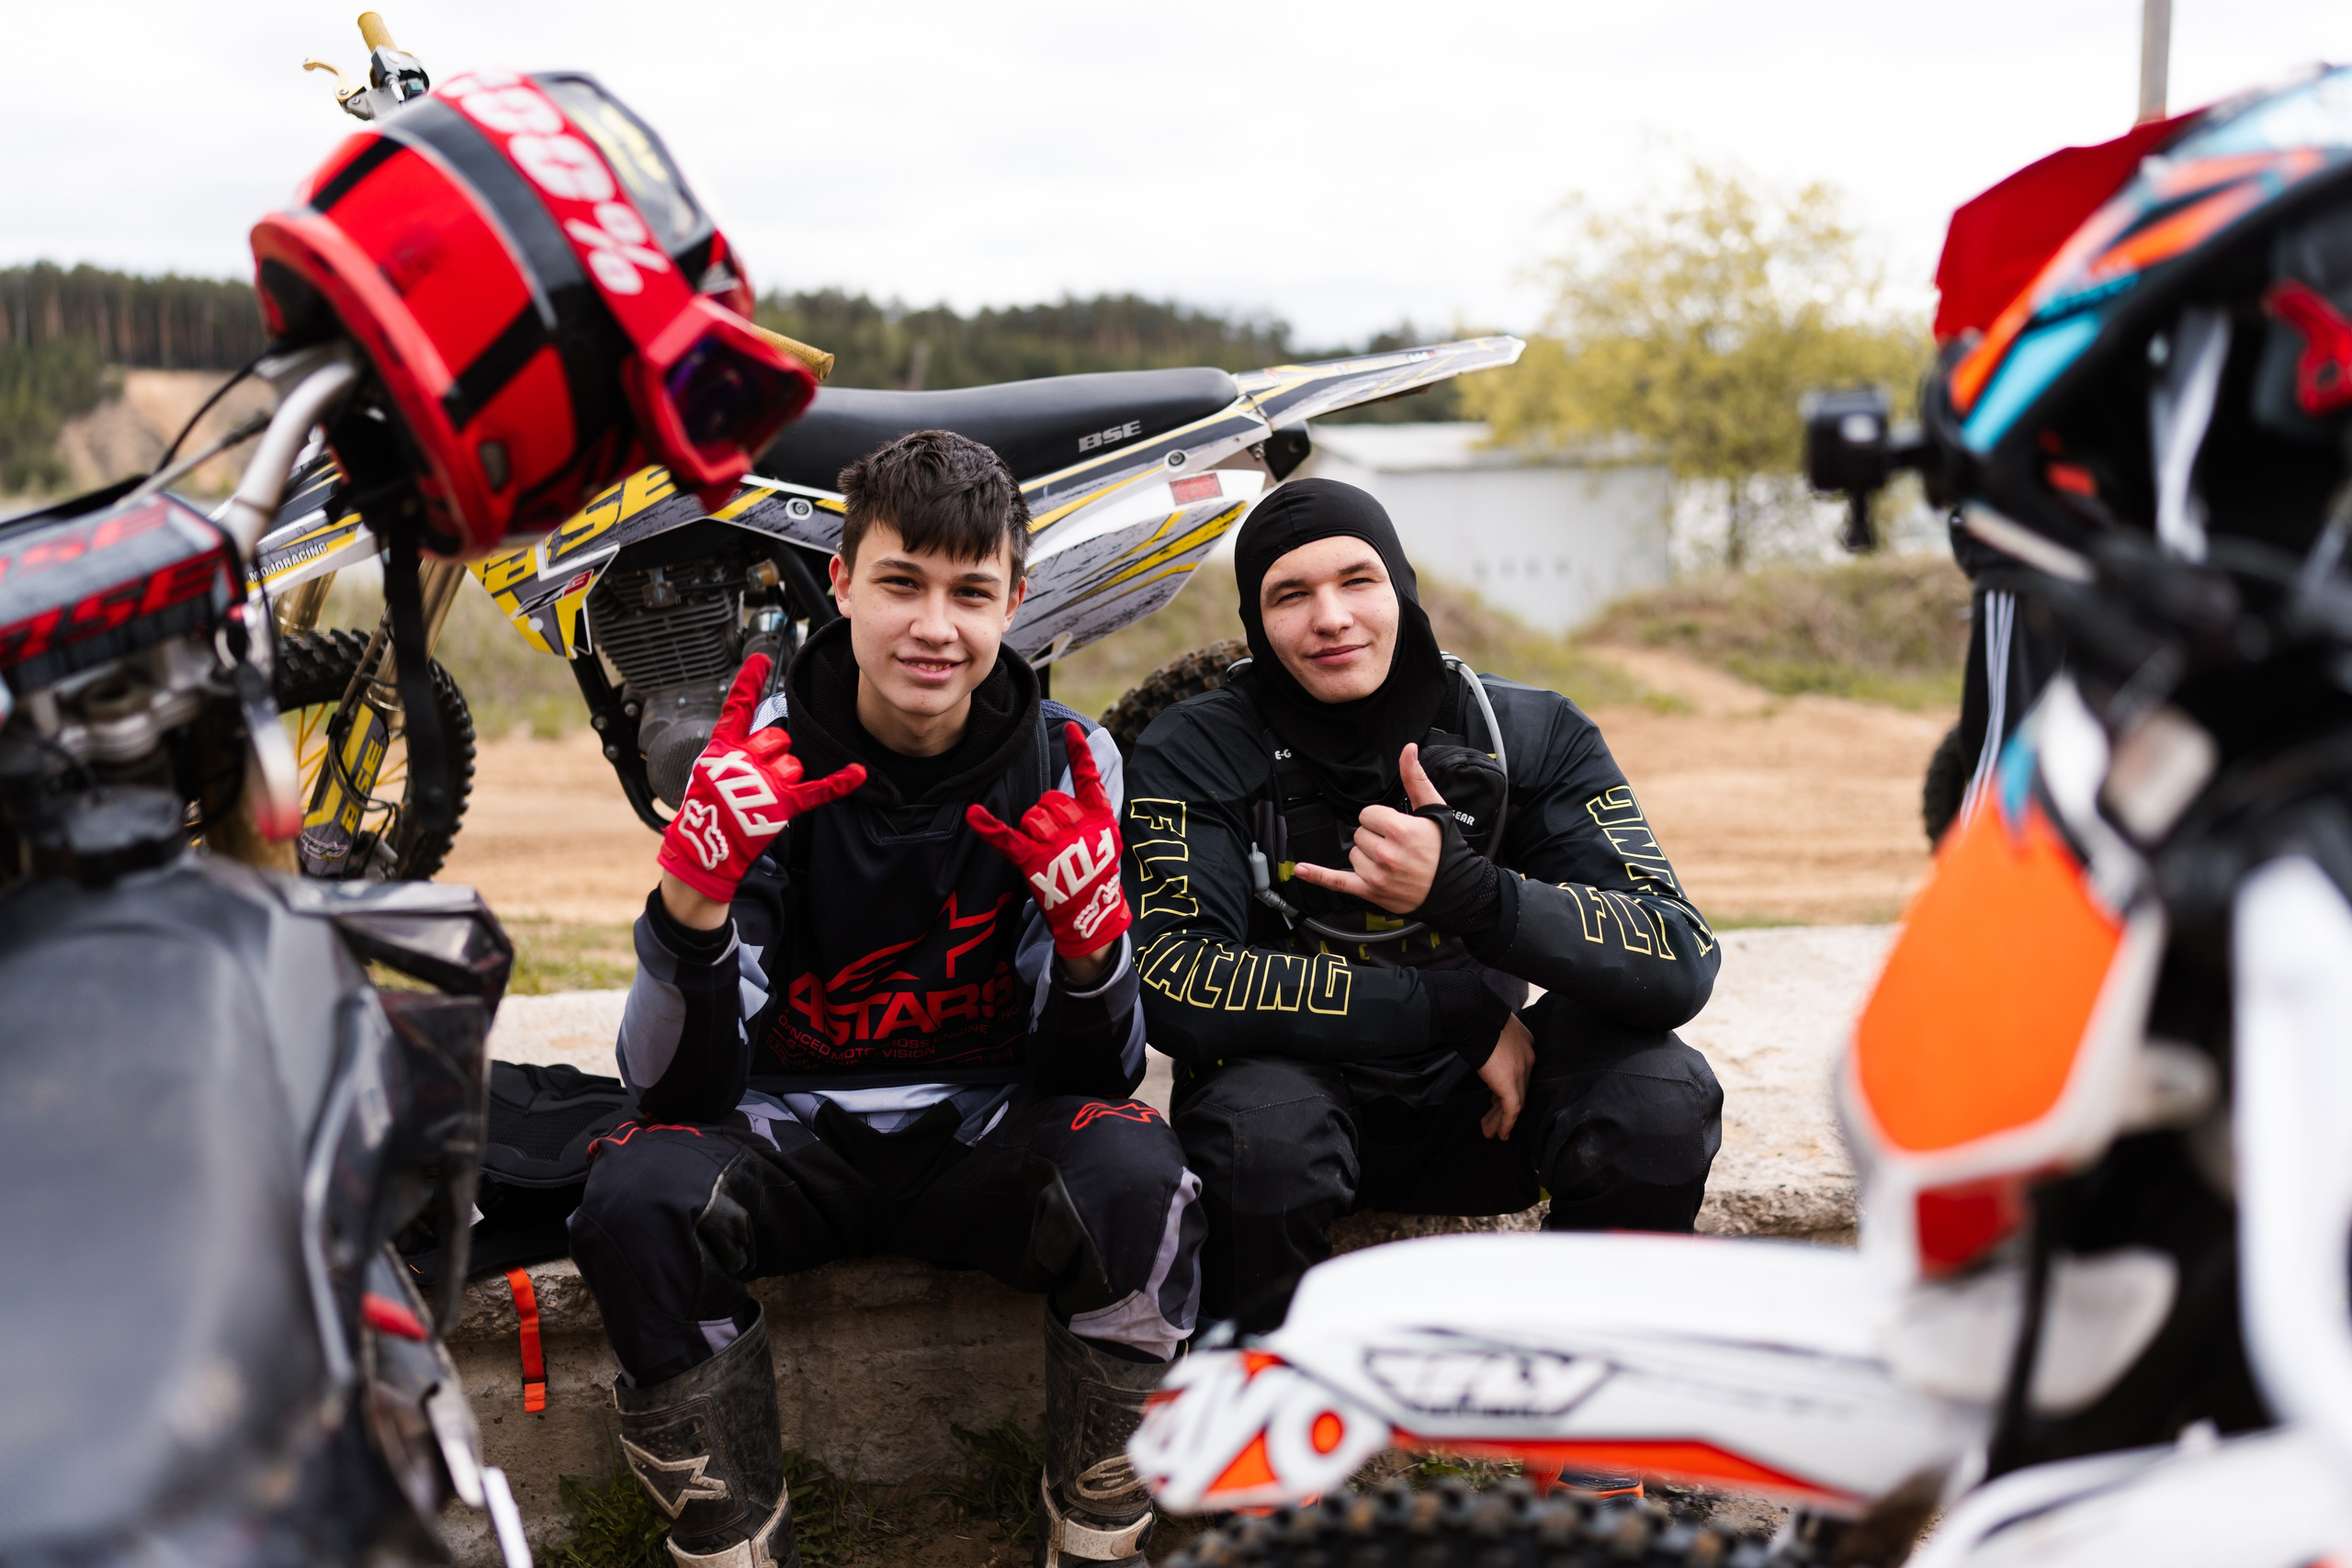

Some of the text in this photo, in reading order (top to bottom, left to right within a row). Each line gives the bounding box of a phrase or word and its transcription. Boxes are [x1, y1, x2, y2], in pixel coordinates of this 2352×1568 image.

[1078, 419, 1142, 453] BSE
[249, 541, 329, 583] MOJORACING
[699, 750, 789, 837] FOX
[1030, 827, 1116, 910] FOX
[1130, 798, 1198, 919] FLY
[883, 1045, 936, 1059] VISION
